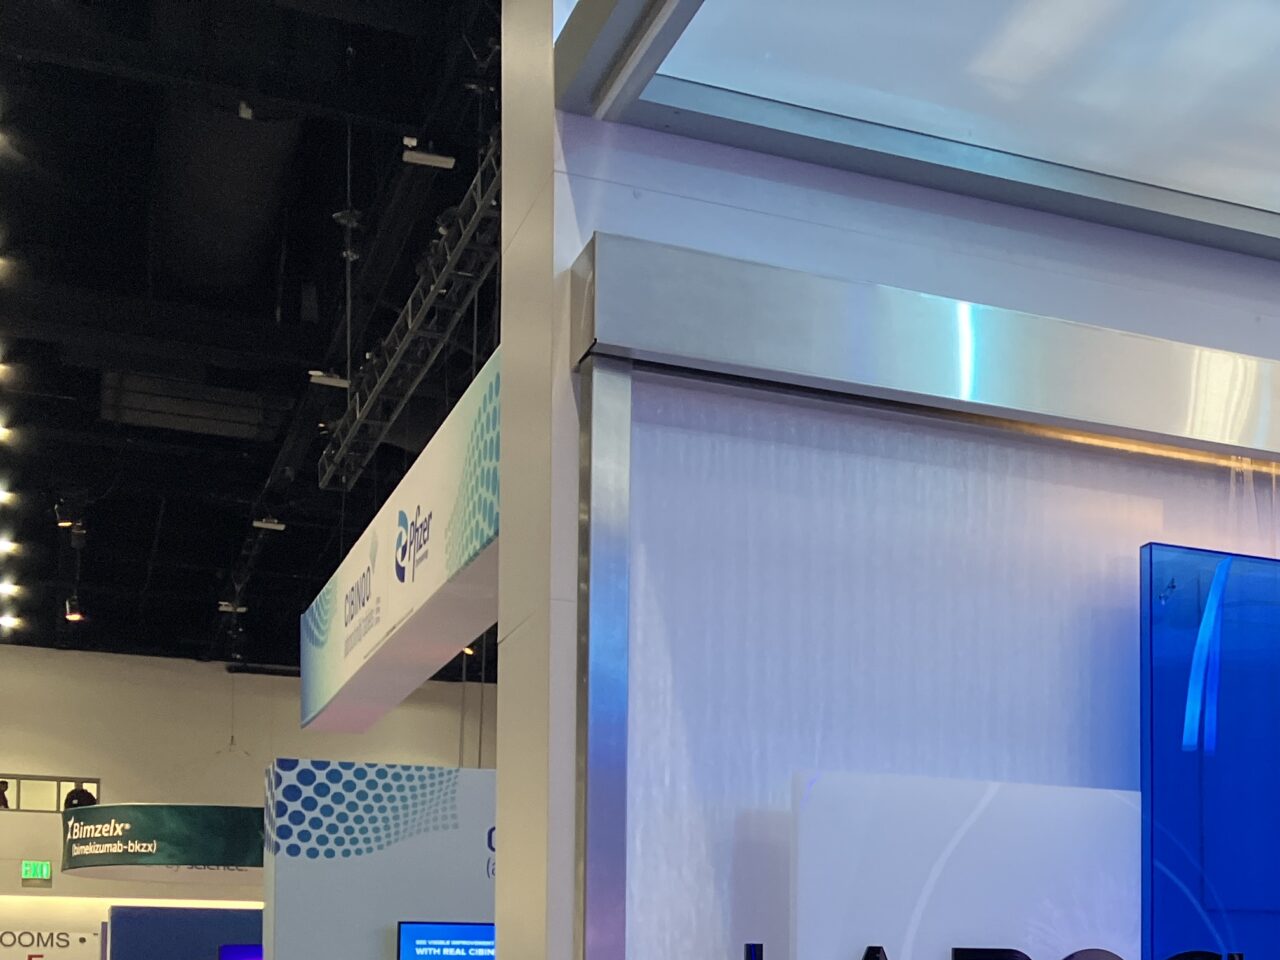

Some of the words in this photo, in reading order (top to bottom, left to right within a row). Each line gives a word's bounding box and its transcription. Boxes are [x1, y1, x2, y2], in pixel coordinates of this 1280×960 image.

[408, 505, 432, 582] Pfizer
[345, 566, 370, 628] CIBINQO
[72, 840, 156, 857] (bimekizumab-bkzx)
[443, 948, 466, 956] REAL
